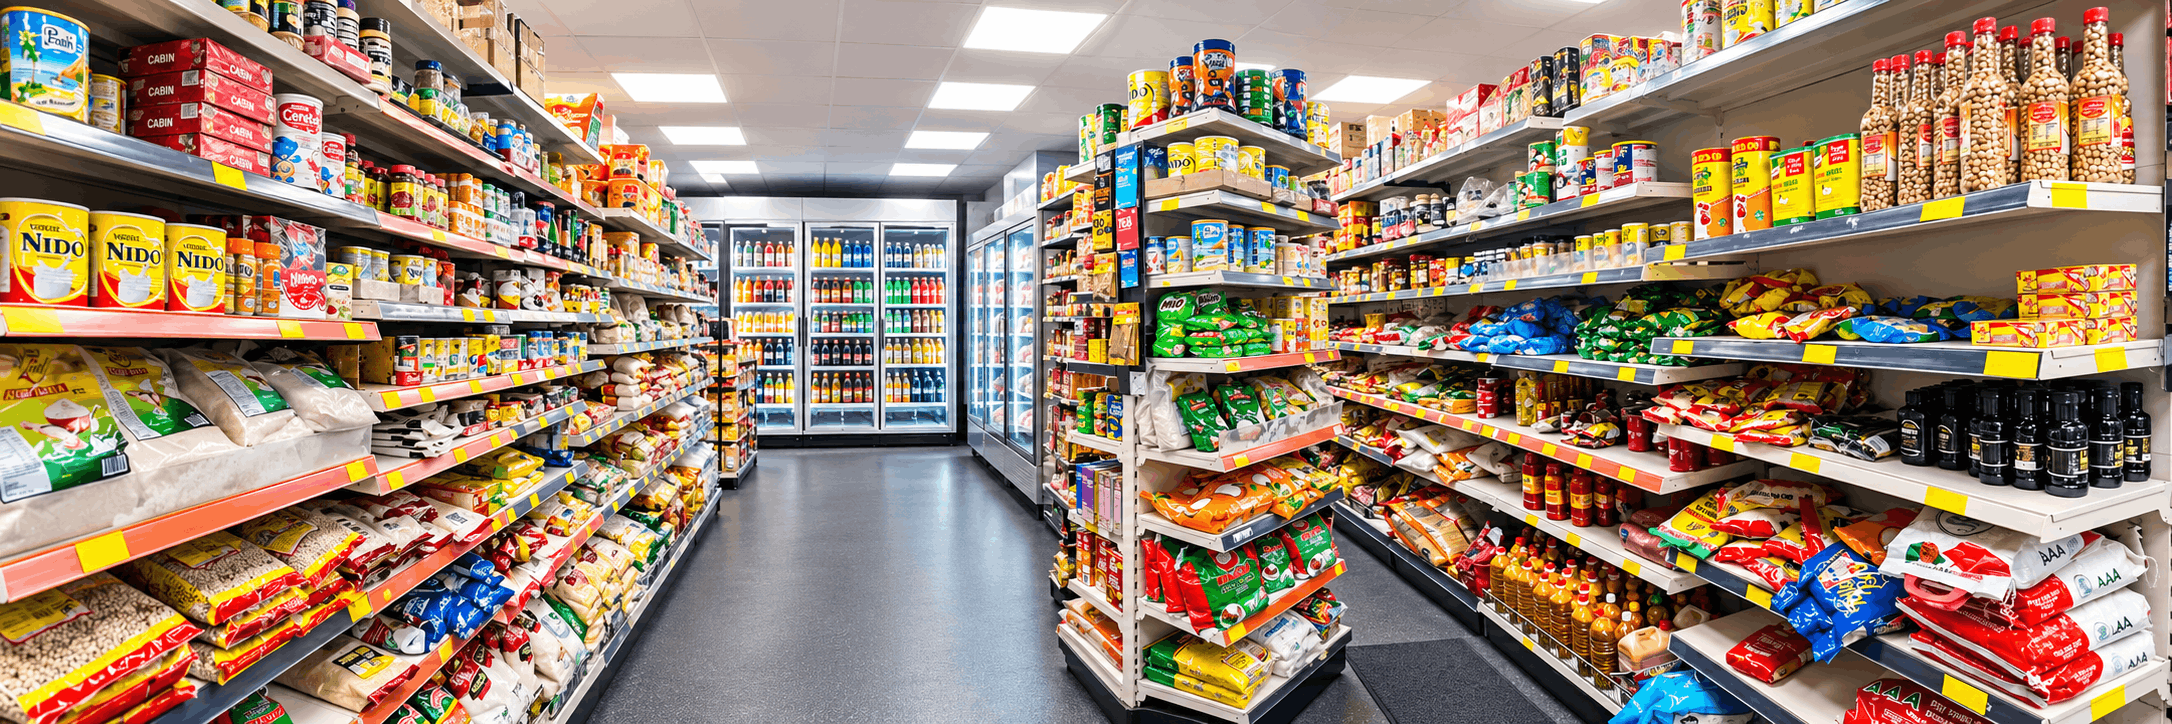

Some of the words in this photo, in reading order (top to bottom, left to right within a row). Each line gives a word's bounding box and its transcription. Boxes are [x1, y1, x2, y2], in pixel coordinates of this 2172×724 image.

[148, 53, 175, 65] CABIN
[148, 85, 174, 97] CABIN
[147, 117, 173, 129] CABIN
[21, 232, 85, 258] NIDO
[106, 242, 161, 265] NIDO
[177, 250, 224, 272] NIDO
[2038, 544, 2066, 566] AAA
[2098, 568, 2121, 588] AAA
[1862, 680, 1921, 712] AAA
